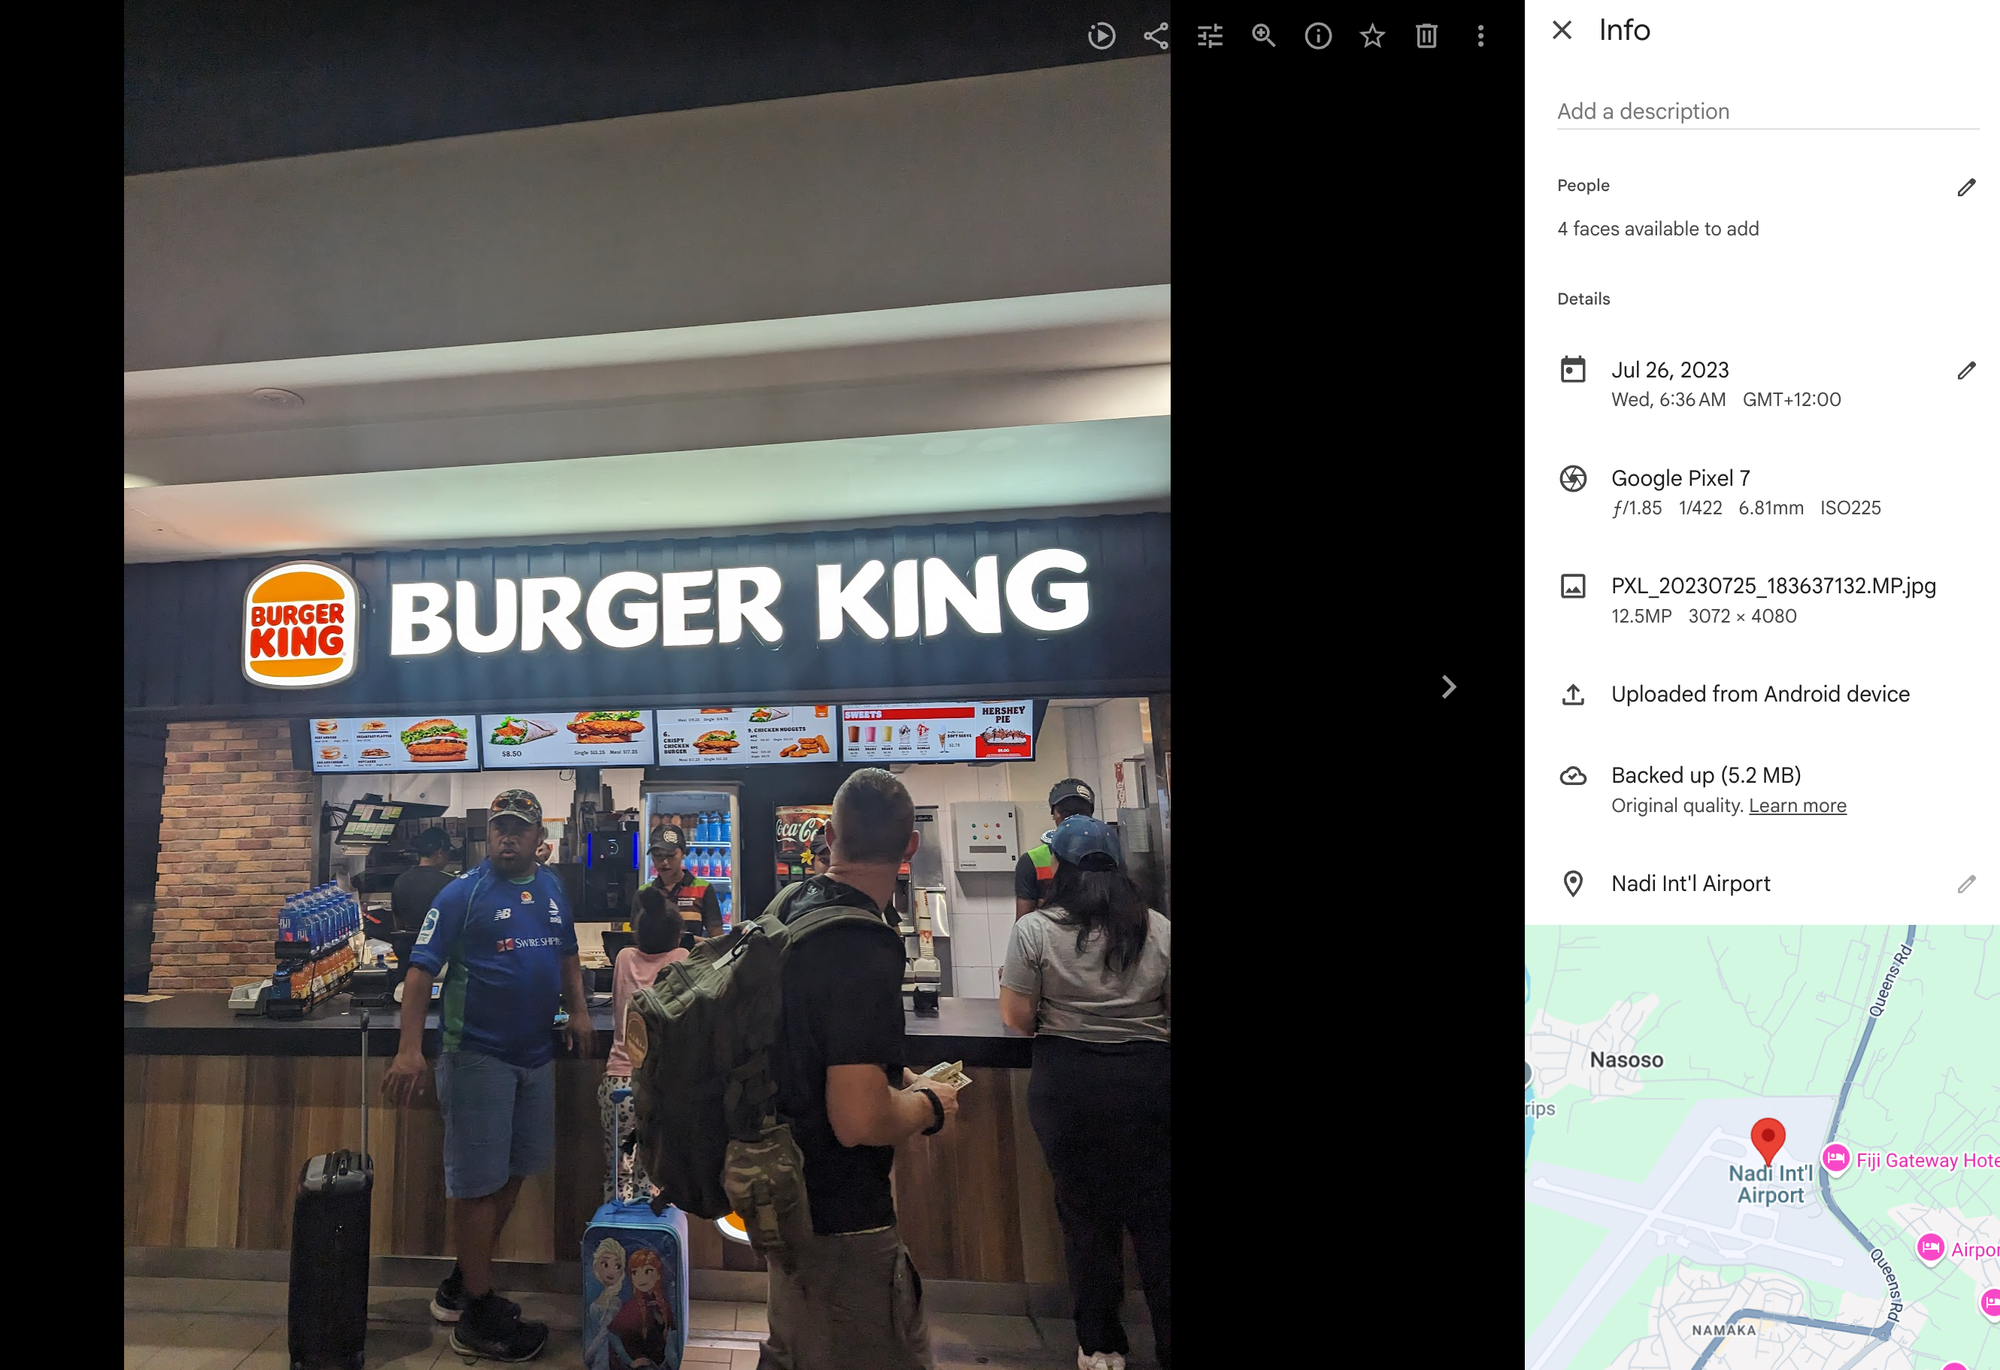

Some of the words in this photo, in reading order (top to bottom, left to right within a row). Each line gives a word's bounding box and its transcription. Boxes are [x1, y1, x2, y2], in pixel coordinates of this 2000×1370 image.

[391, 566, 784, 656] BURGER
[816, 548, 1090, 641] KING
[251, 603, 345, 627] BURGER
[250, 625, 344, 658] KING
[845, 711, 882, 719] SWEETS
[982, 706, 1025, 715] HERSHEY
[515, 938, 541, 949] SWIRE
